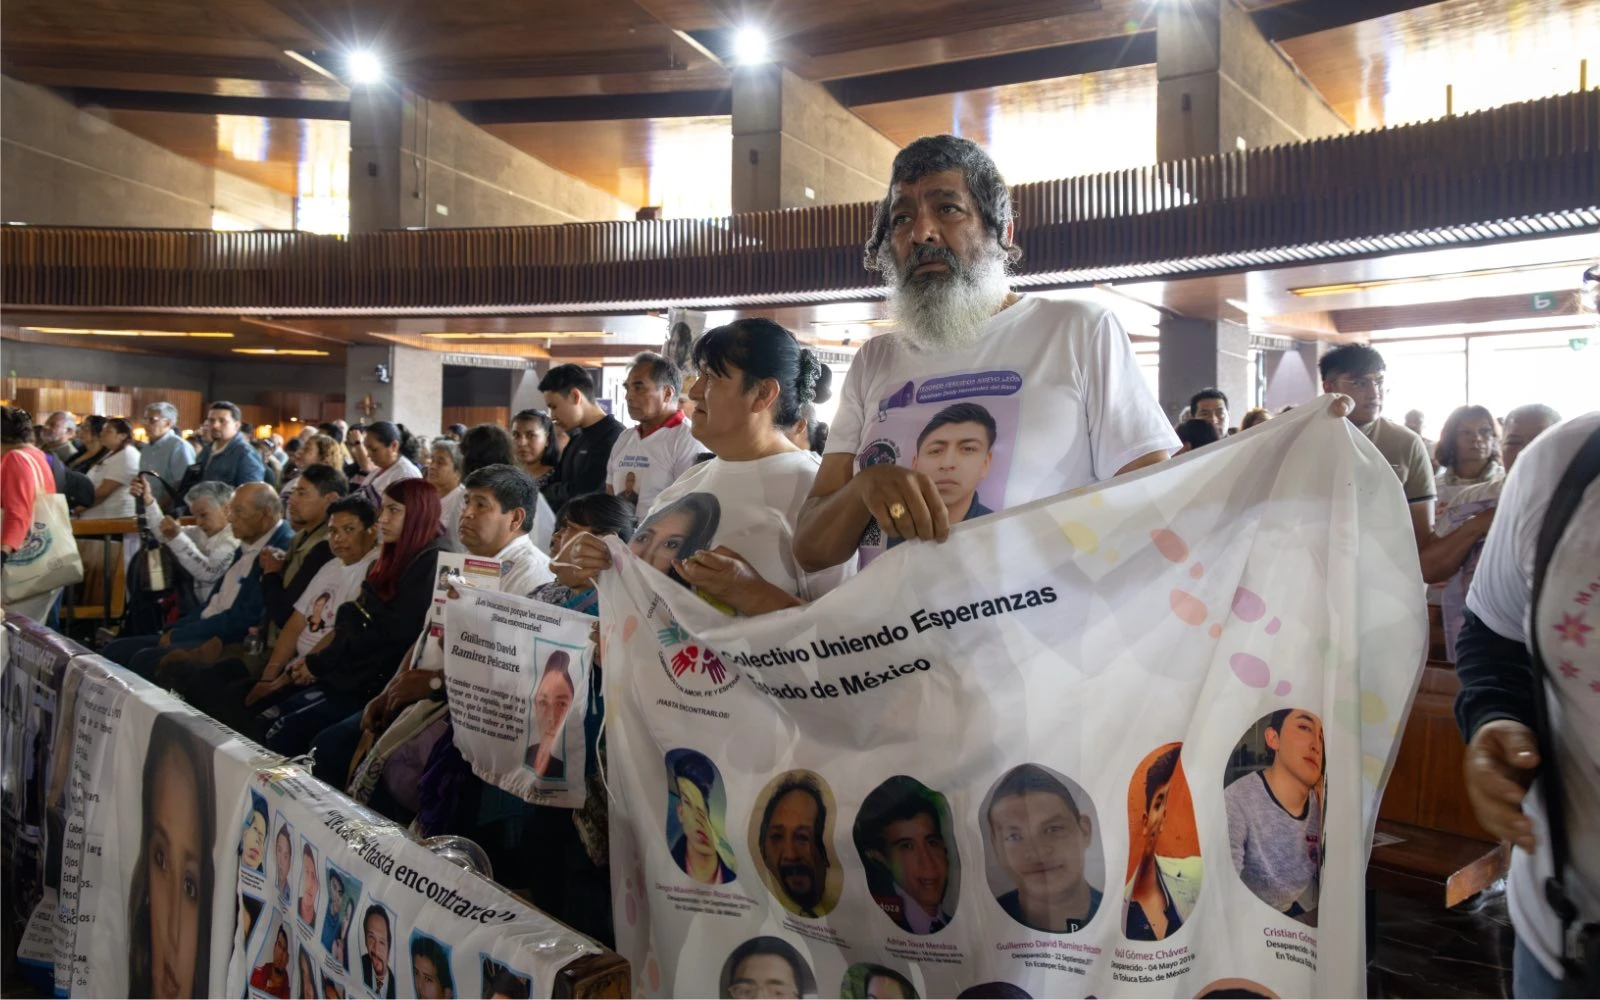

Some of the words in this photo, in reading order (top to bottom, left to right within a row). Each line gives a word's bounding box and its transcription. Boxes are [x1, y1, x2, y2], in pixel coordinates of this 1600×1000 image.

[510, 607, 528, 618] porque
[810, 625, 909, 659] Uniendo
[910, 585, 1058, 634] Esperanzas
[460, 631, 496, 651] Guillermo
[496, 640, 516, 656] David
[487, 652, 520, 673] Pelcastre
[810, 680, 839, 700] de
[839, 658, 931, 696] México
[656, 697, 679, 710] ¡HASTA
[68, 822, 83, 834] Cabe
[64, 855, 78, 867] Ojos
[363, 842, 395, 876] hasta
[394, 863, 517, 924] encontrarte”
[1263, 927, 1298, 940] Cristian
[996, 941, 1034, 951] Guillermo
[1035, 939, 1057, 949] David
[1011, 952, 1051, 960] Desaparecido
[1125, 949, 1154, 961] Gómez
[1155, 946, 1188, 960] Chávez
[1275, 951, 1285, 960] En
[1285, 952, 1304, 964] Toluca
[1110, 960, 1143, 972] Desaparecido
[1159, 960, 1178, 970] Mayo
[1119, 973, 1138, 983] Toluca
[1139, 975, 1154, 983] Edo.
[1155, 974, 1165, 982] de
[1166, 967, 1190, 979] México
